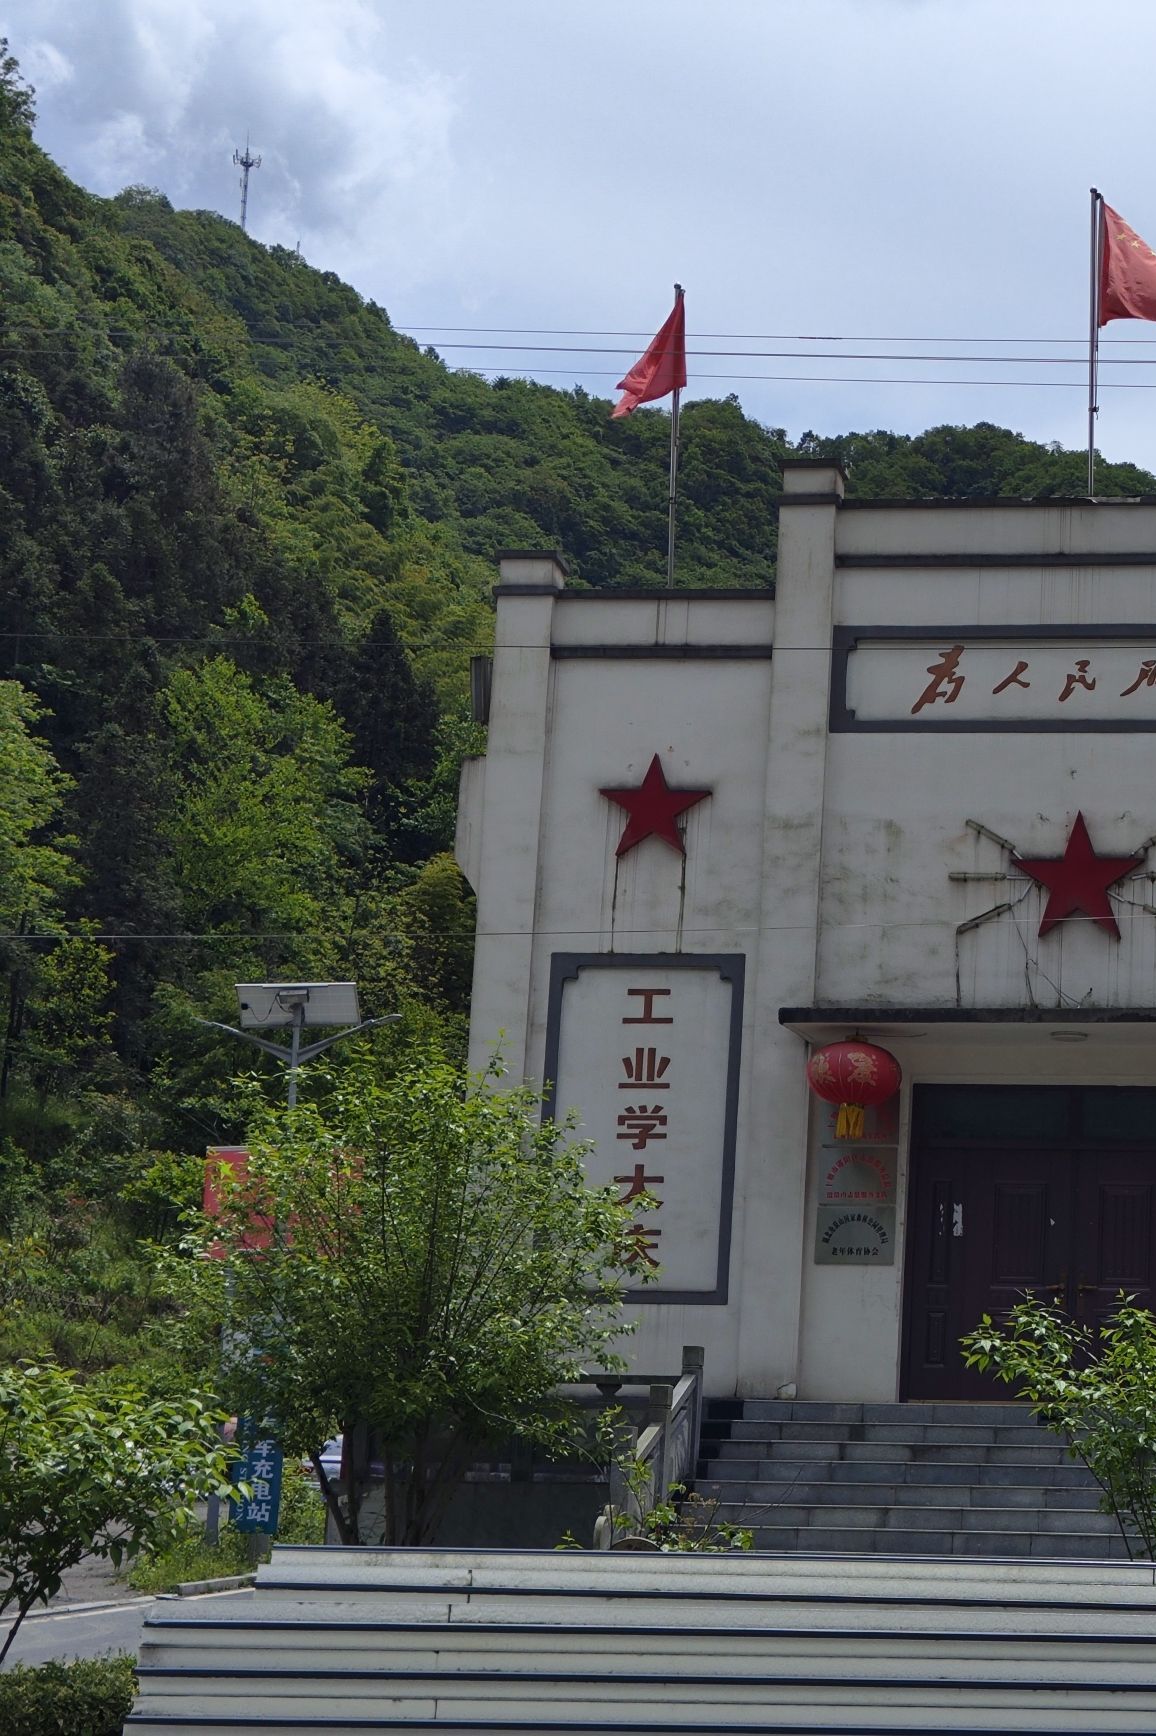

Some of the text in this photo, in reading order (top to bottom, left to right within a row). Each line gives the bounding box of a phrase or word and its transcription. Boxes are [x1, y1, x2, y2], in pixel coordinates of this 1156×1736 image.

[612, 988, 674, 1269] 工业学大庆
